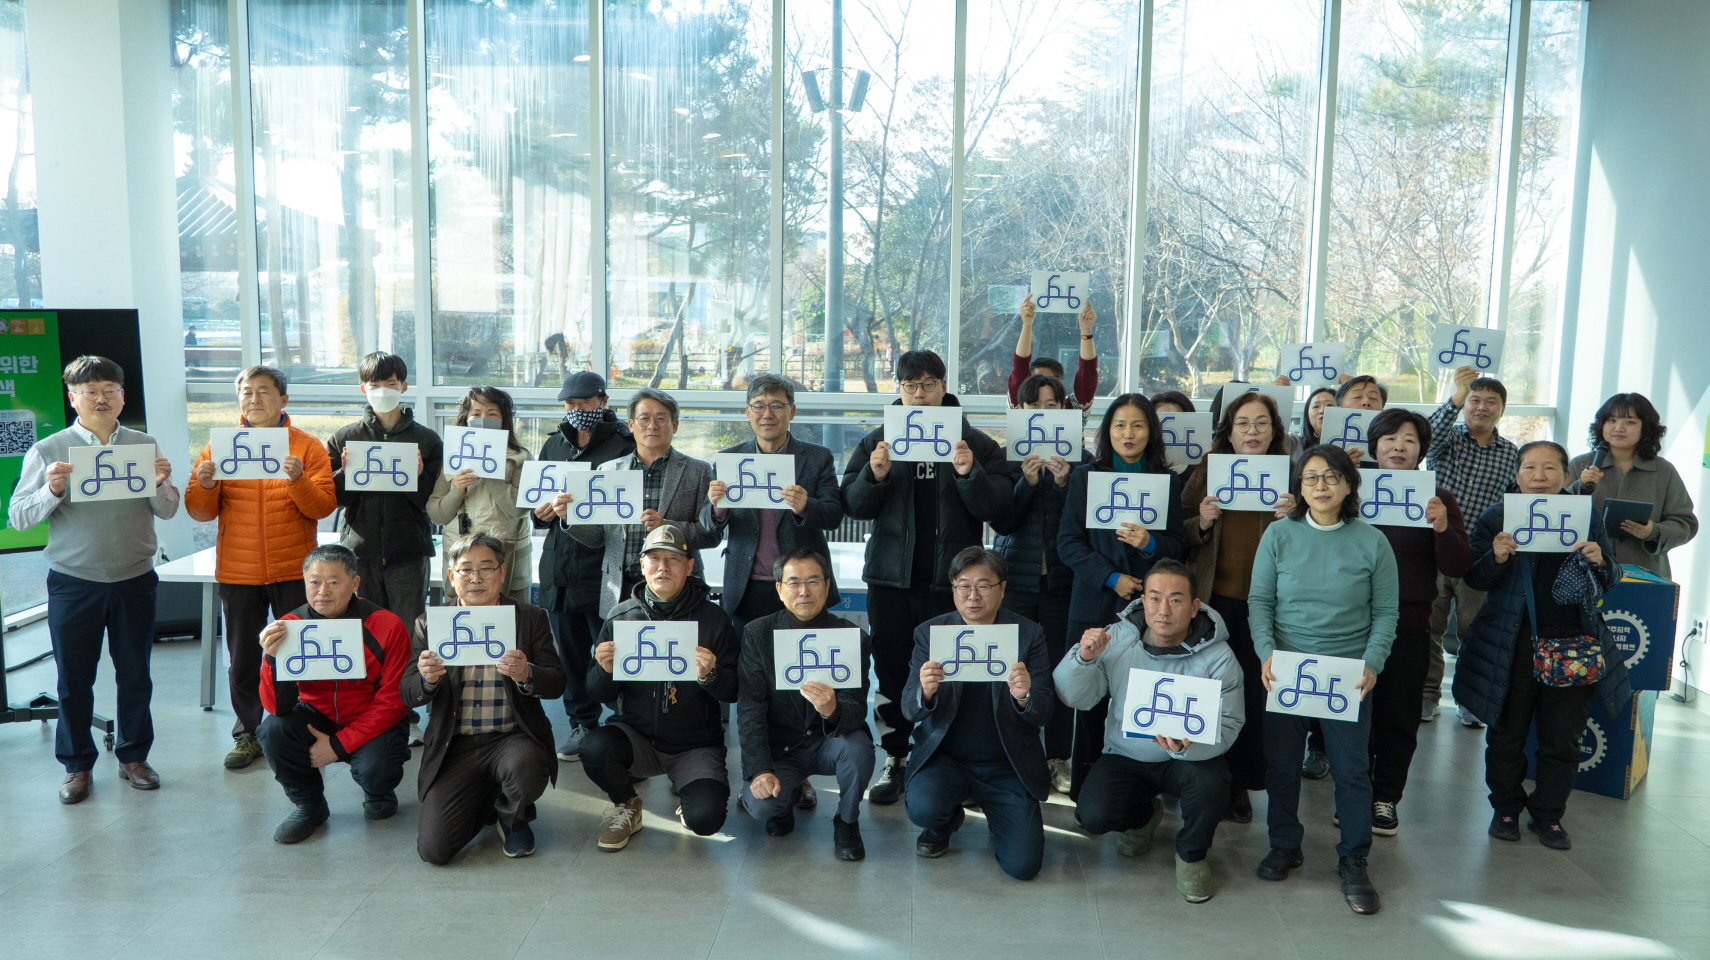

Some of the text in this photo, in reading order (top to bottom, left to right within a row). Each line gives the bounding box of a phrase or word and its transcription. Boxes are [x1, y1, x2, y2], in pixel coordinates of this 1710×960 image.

[0, 355, 38, 374] 위한
[914, 462, 936, 480] CE
[1607, 626, 1631, 634] 주지역
[1616, 643, 1636, 651] 트워크
